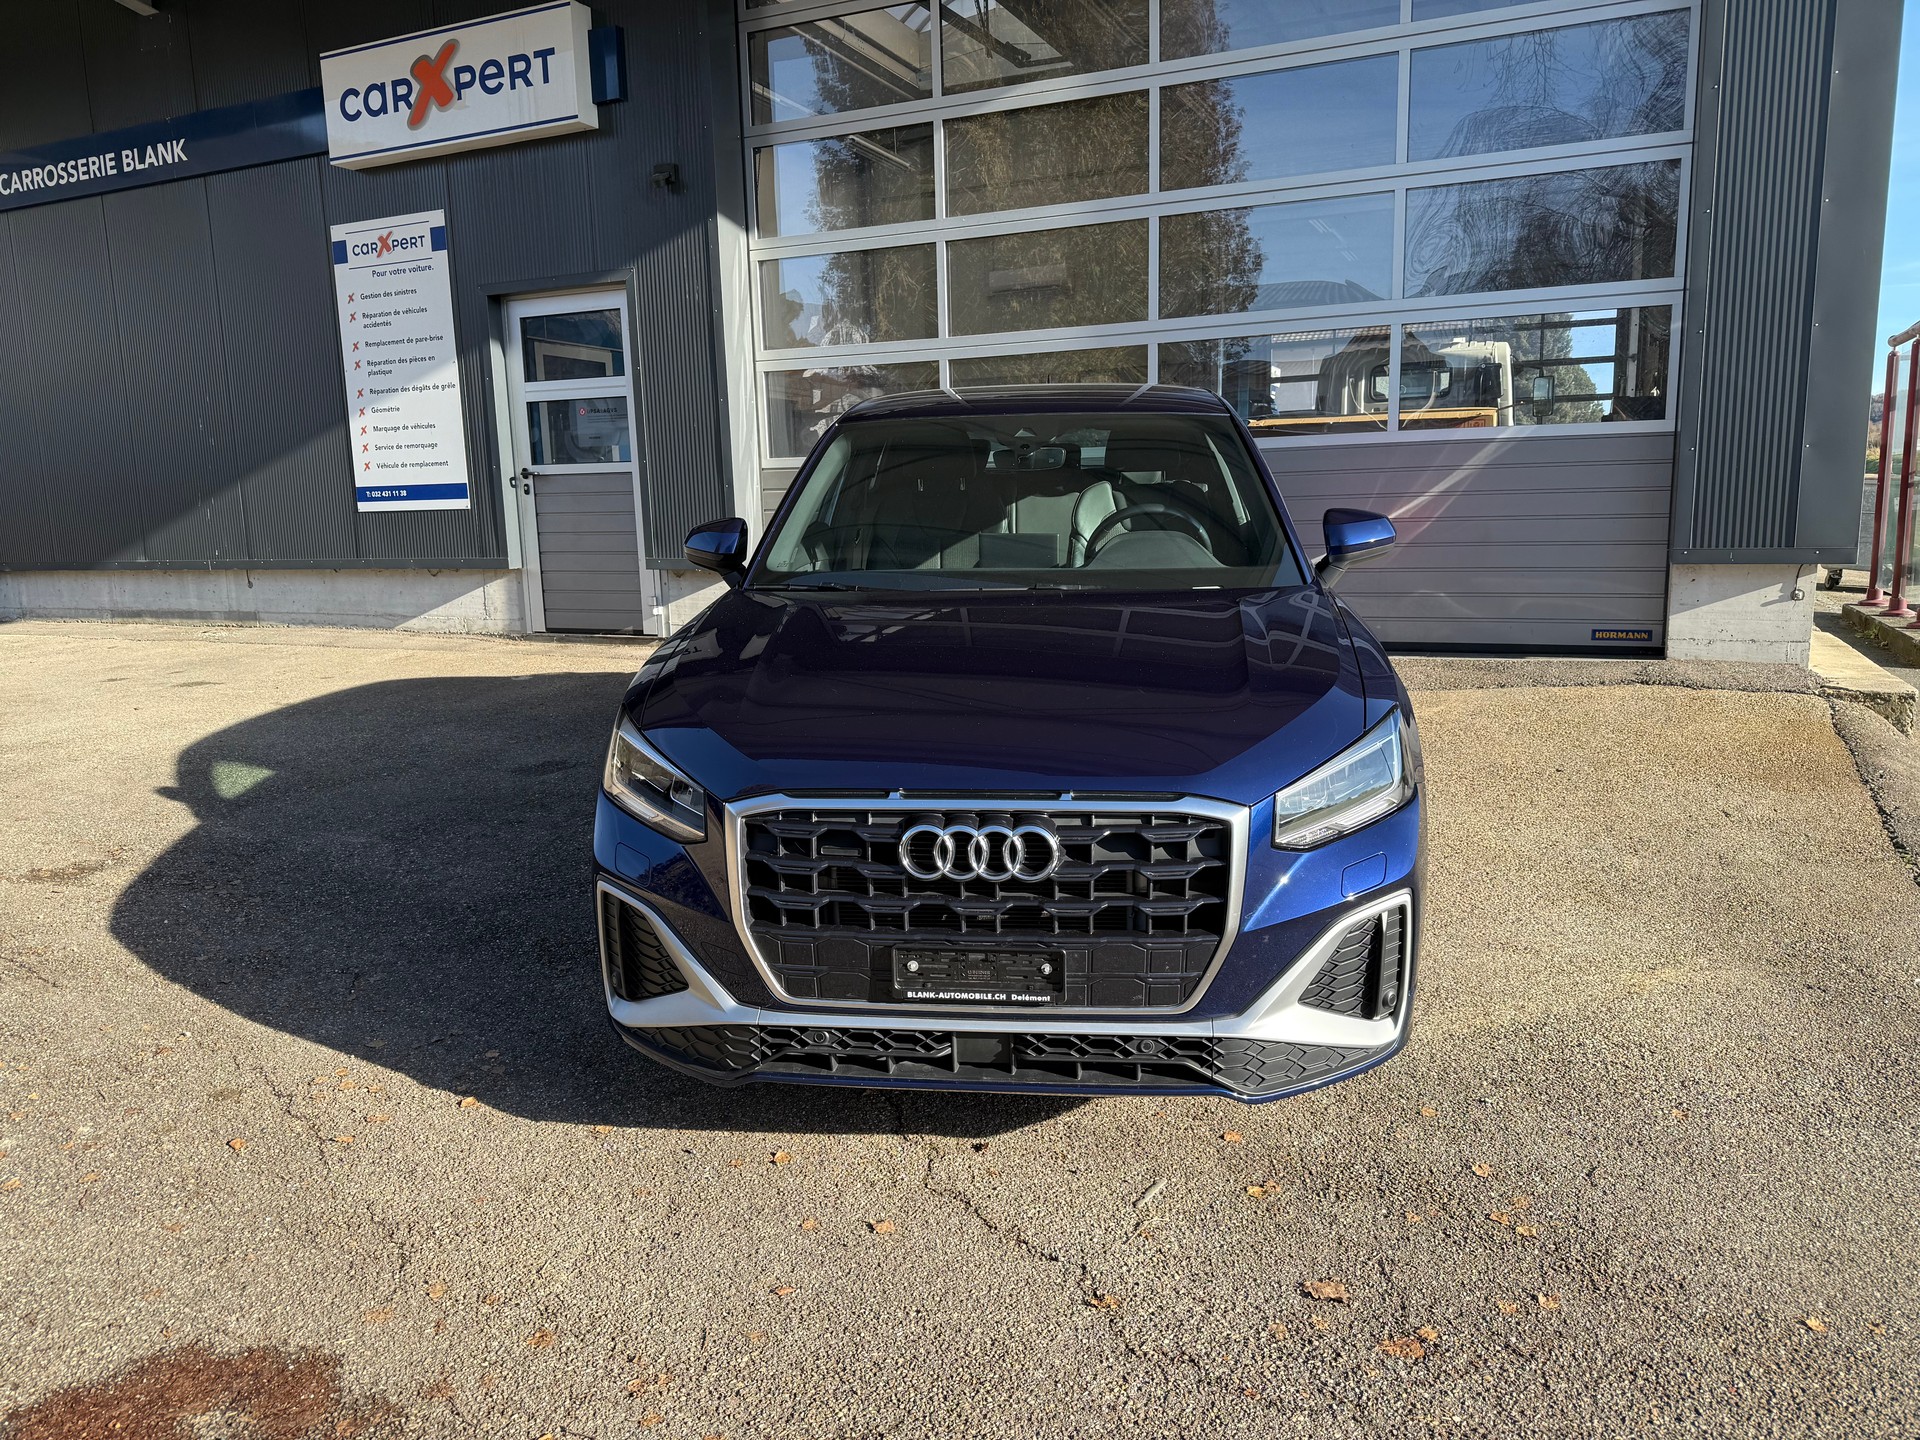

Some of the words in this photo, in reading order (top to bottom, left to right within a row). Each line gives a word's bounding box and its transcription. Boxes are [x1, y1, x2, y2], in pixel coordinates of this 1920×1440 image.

[0, 153, 117, 196] CARROSSERIE
[121, 138, 188, 173] BLANK
[372, 269, 387, 278] Pour
[388, 268, 407, 276] votre
[408, 264, 434, 274] voiture.
[360, 291, 382, 300] Gestion
[382, 290, 393, 298] des
[393, 288, 417, 296] sinistres
[362, 309, 393, 320] Réparation
[393, 308, 401, 316] de
[401, 306, 428, 315] véhicules
[363, 320, 392, 329] accidentés
[364, 338, 405, 348] Remplacement
[406, 336, 414, 344] de
[415, 334, 444, 344] pare-brise
[366, 358, 397, 368] Réparation
[399, 356, 408, 364] des
[409, 355, 427, 365] pièces
[367, 368, 393, 378] plastique
[369, 387, 399, 396] Réparation
[400, 385, 410, 393] des
[411, 384, 431, 393] dégâts
[432, 383, 440, 391] de
[441, 382, 456, 391] grêle
[371, 406, 400, 414] Géométrie
[373, 424, 400, 433] Marquage
[410, 422, 436, 430] véhicules
[374, 443, 394, 451] Service
[404, 442, 438, 450] remorquage
[376, 461, 399, 469] Véhicule
[400, 461, 408, 469] de
[409, 460, 449, 469] remplacement
[371, 490, 382, 498] 032
[907, 991, 1006, 1001] BLANK-AUTOMOBILE.CH
[1011, 994, 1051, 1002] Delémont
